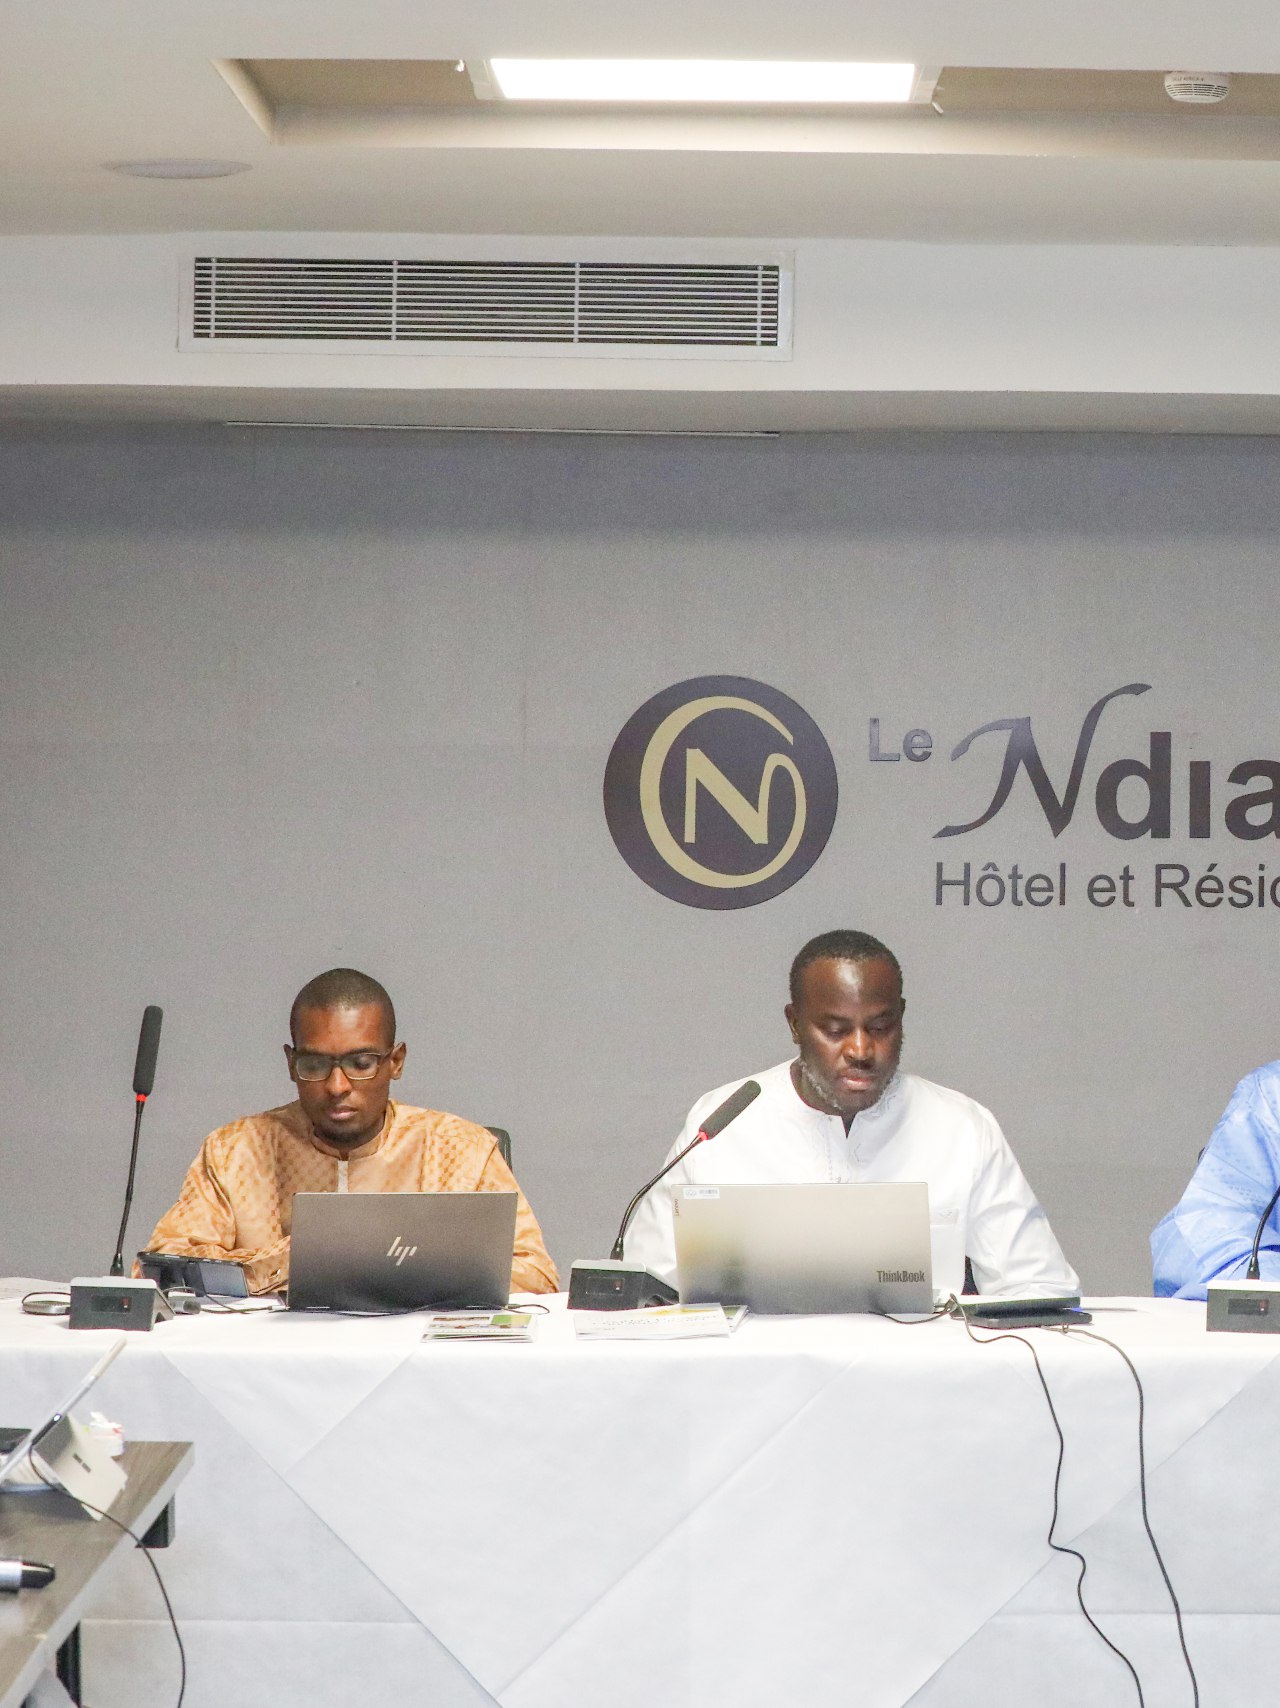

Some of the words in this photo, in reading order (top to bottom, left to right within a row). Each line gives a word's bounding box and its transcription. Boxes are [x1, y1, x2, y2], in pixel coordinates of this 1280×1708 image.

[869, 718, 933, 762] Le
[936, 862, 1067, 907] Hôtel
[1087, 867, 1135, 907] et
[876, 1270, 926, 1282] ThinkBook
